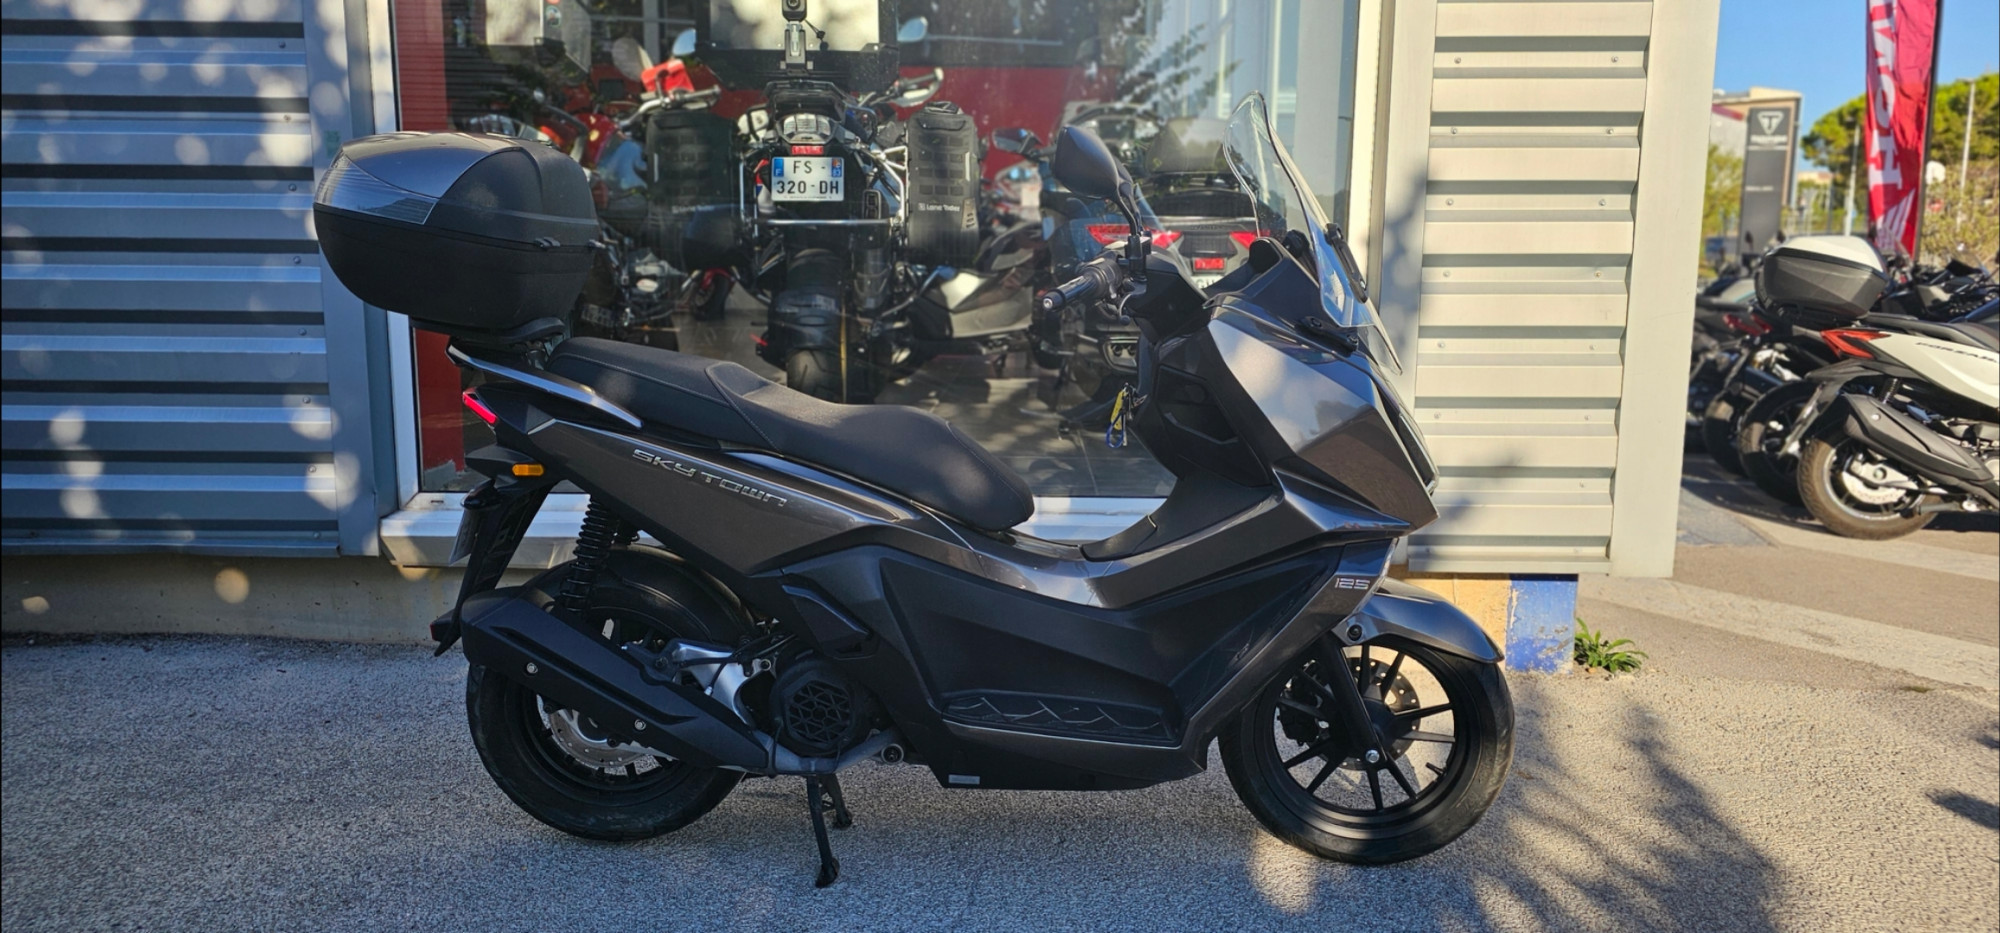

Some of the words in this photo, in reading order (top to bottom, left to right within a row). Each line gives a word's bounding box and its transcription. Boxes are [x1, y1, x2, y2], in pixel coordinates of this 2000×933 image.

[1869, 0, 1902, 191] HON
[792, 160, 812, 174] FS
[1334, 577, 1371, 590] 125
